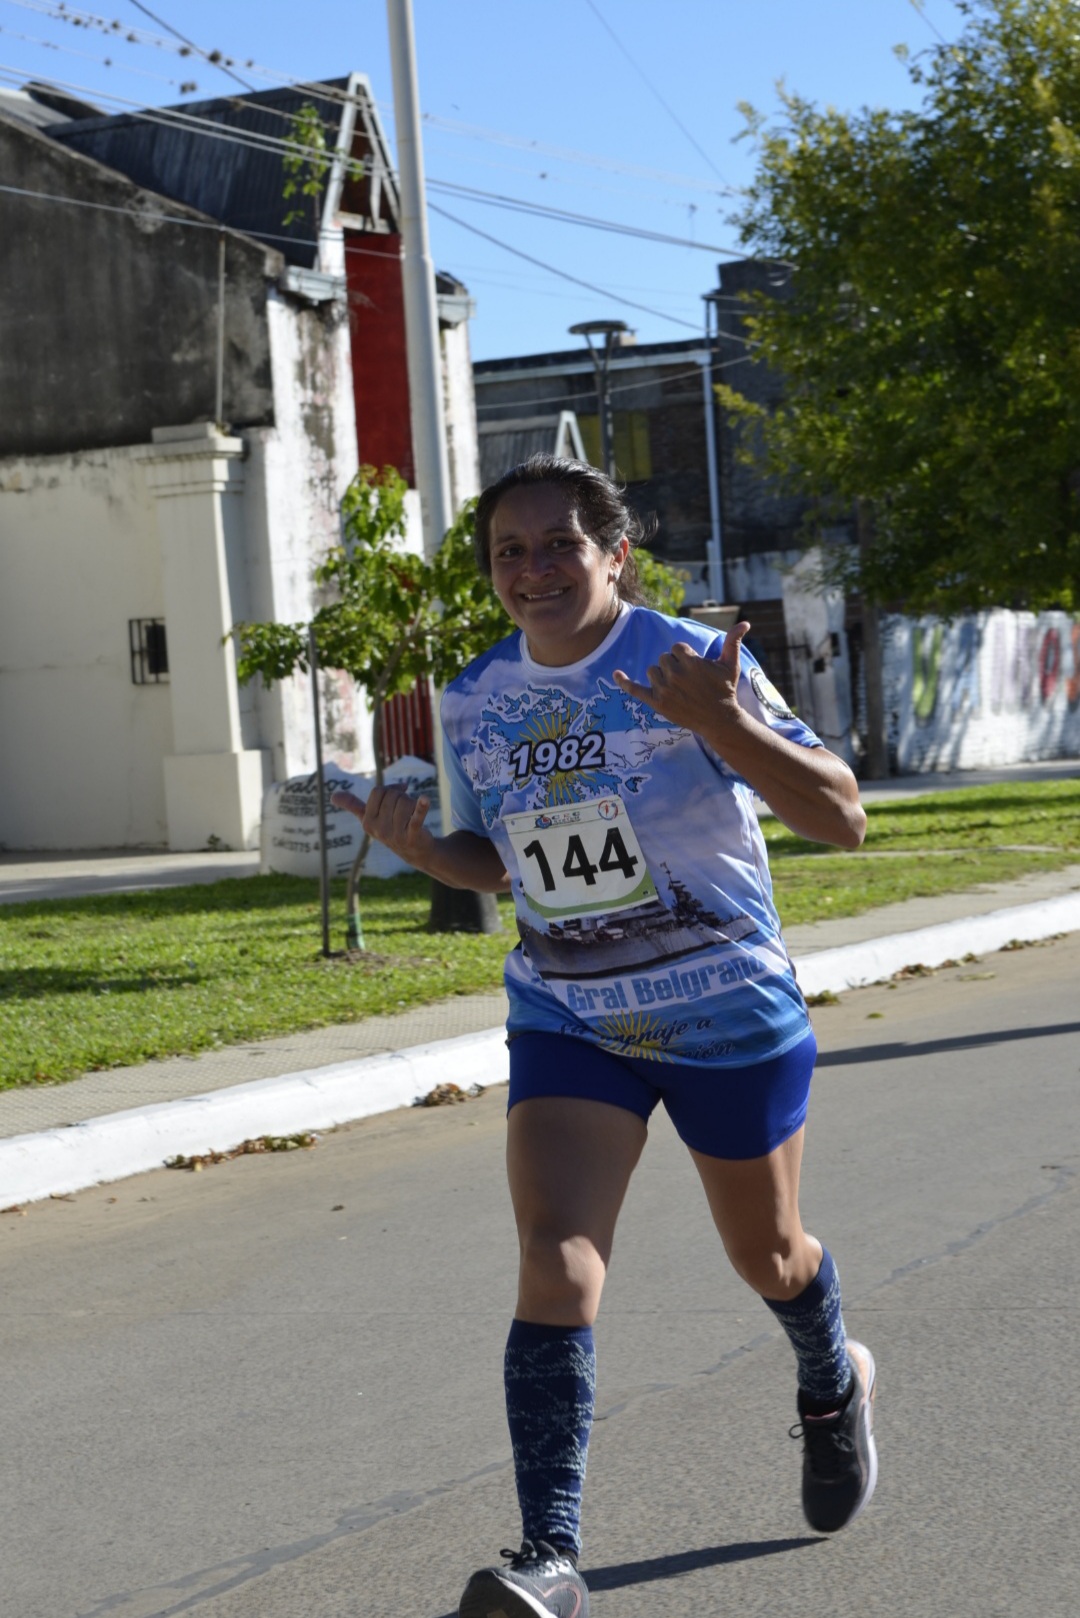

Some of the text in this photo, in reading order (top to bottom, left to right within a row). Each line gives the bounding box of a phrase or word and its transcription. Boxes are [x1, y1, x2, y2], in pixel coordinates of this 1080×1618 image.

[509, 731, 605, 778] 1982
[523, 827, 639, 892] 144
[567, 980, 629, 1012] Gral
[697, 1017, 714, 1031] a
